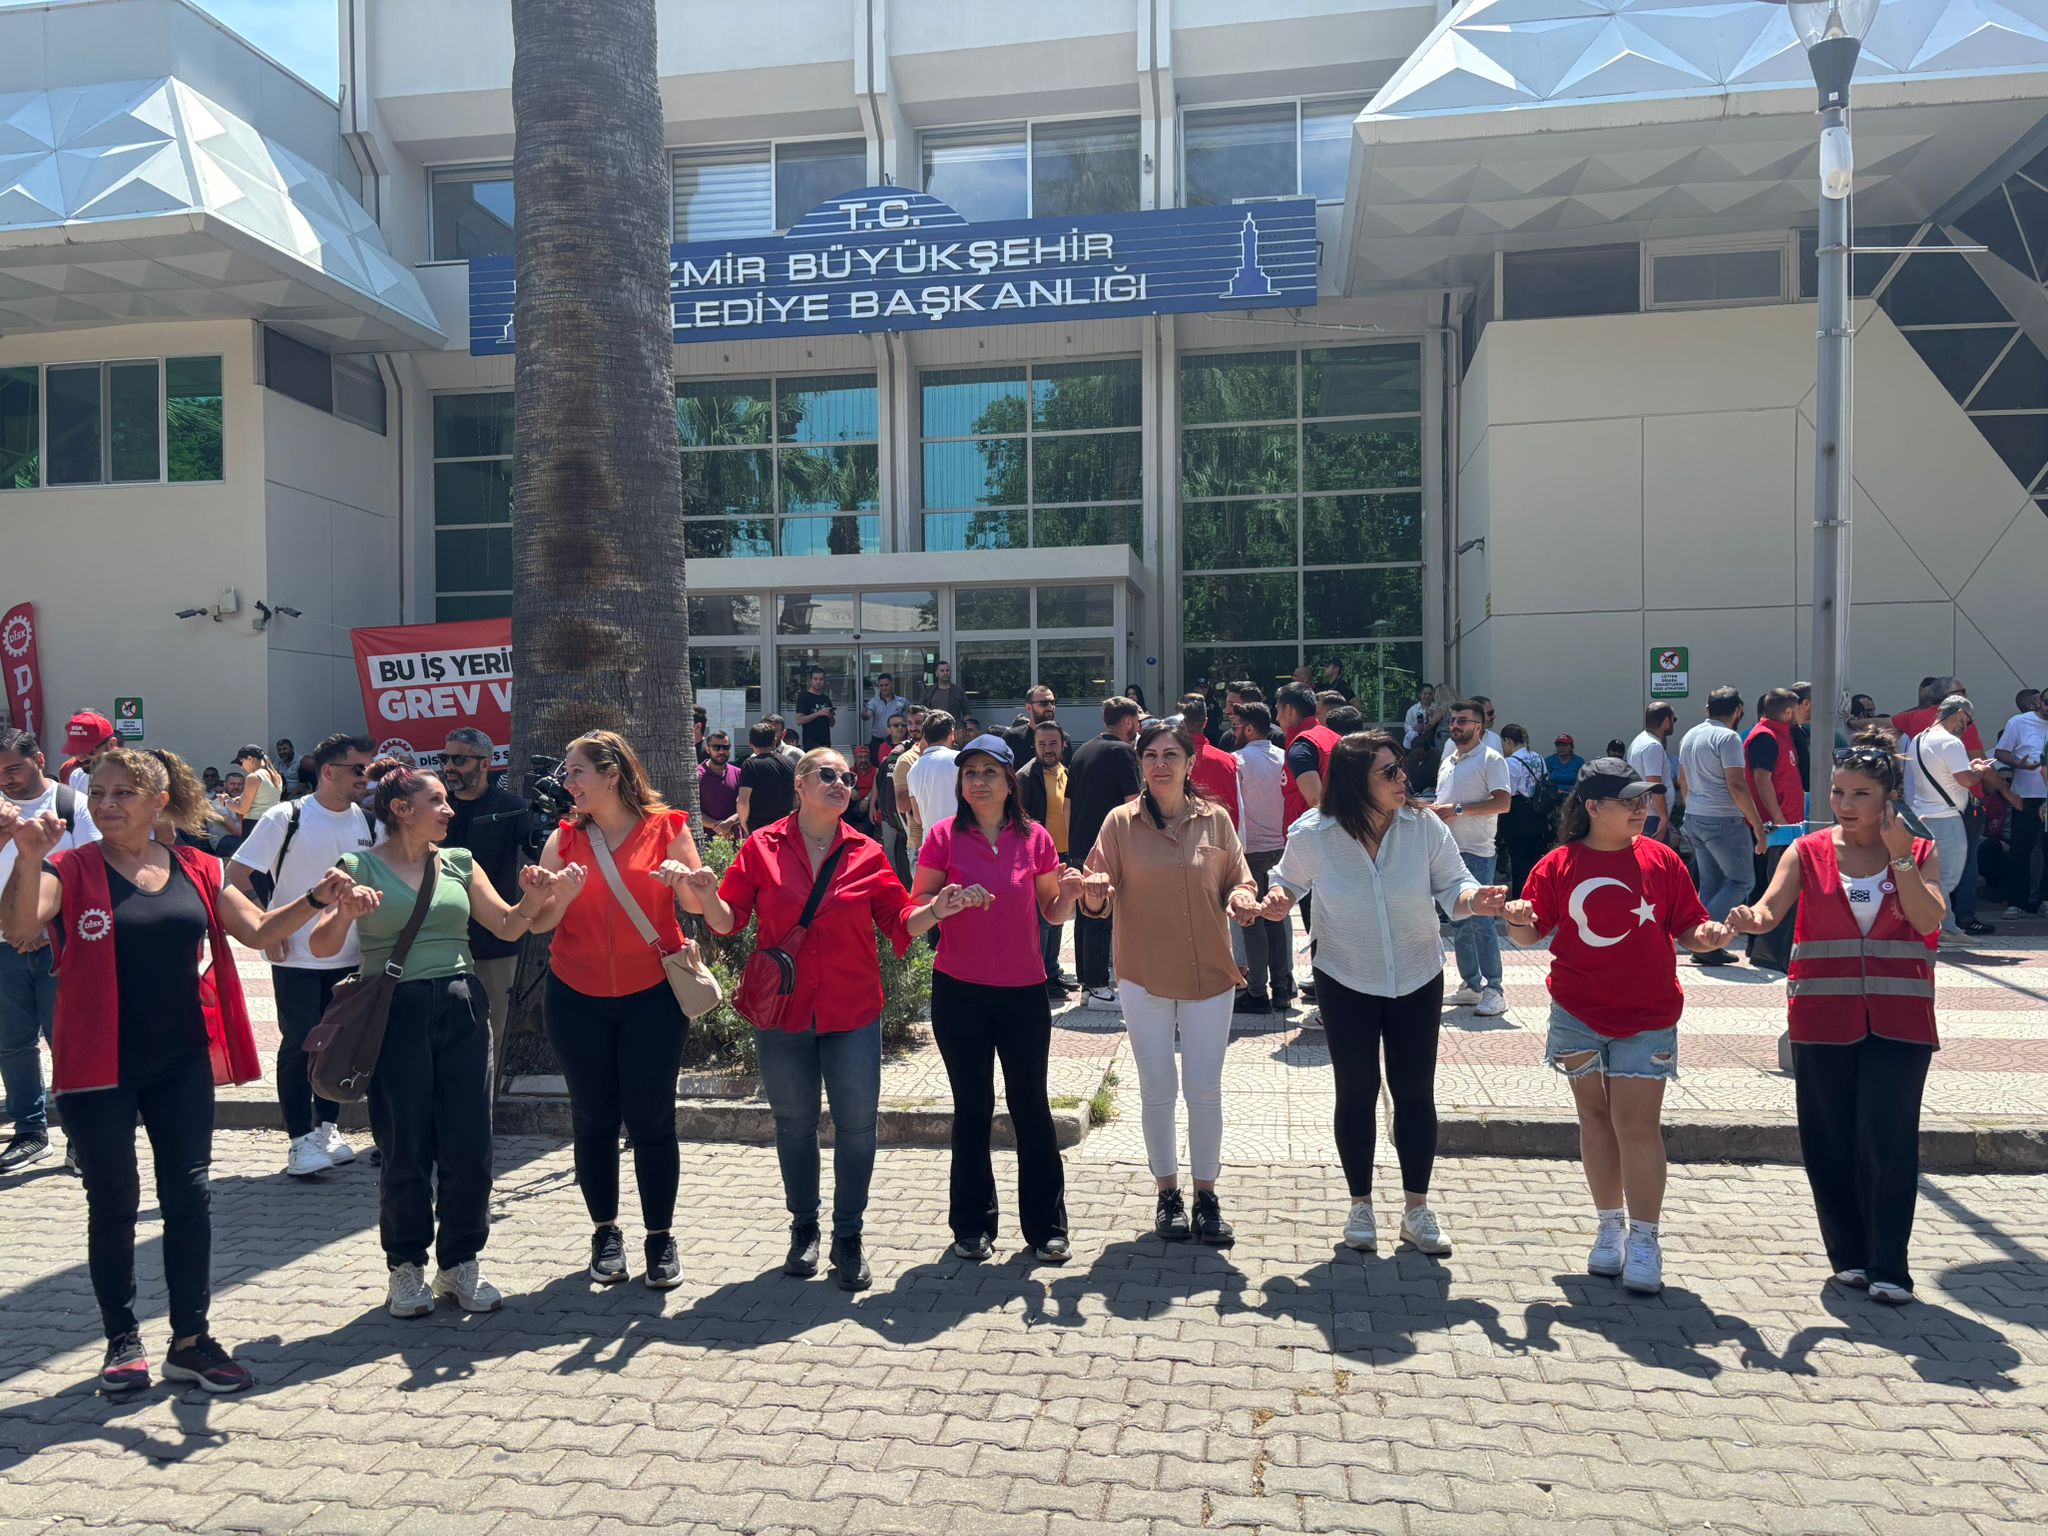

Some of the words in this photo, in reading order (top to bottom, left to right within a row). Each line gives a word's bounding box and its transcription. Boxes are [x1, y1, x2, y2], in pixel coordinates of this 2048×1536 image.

[839, 200, 921, 230] T.C.
[788, 227, 1113, 281] BÜYÜKŞEHİR
[850, 264, 1147, 321] BAŞKANLIĞI
[378, 659, 415, 682] BU
[420, 653, 446, 682] İŞ
[378, 684, 481, 722] GREV
